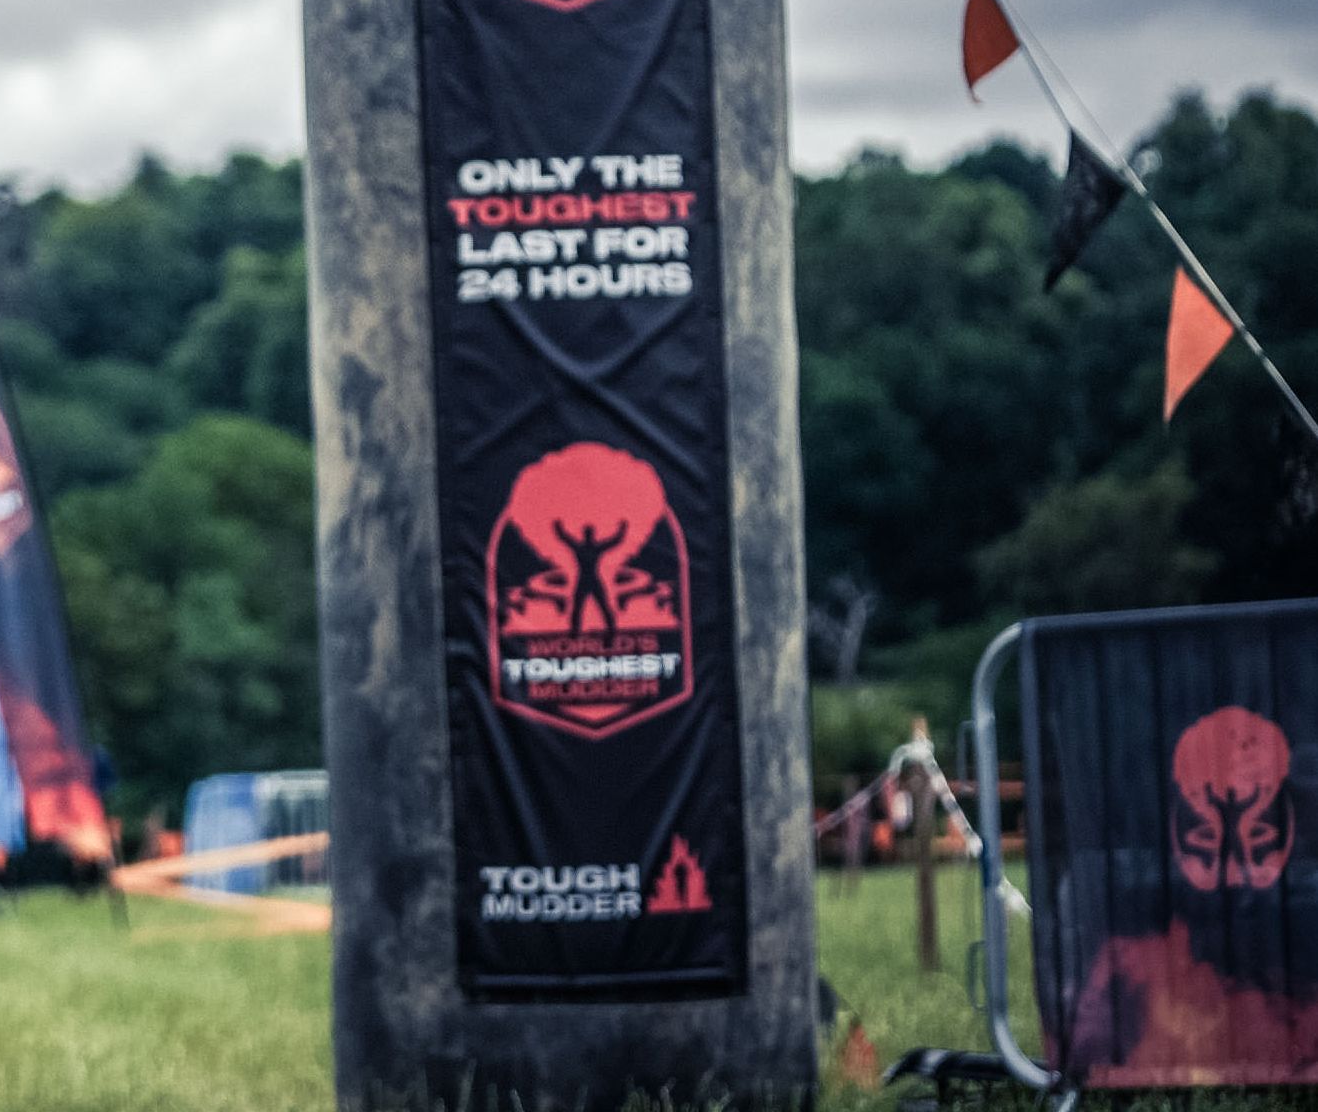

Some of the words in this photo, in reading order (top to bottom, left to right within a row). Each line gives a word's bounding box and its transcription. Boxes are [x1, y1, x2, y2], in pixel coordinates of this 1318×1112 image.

[458, 156, 584, 194] ONLY
[591, 154, 684, 188] THE
[447, 191, 697, 227] TOUGHEST
[458, 229, 586, 265] LAST
[593, 226, 689, 261] FOR
[457, 269, 521, 302] 24
[528, 262, 693, 300] HOURS
[503, 653, 682, 684] TOUGHEST
[479, 864, 641, 892] TOUGH
[482, 891, 642, 922] MUDDER
